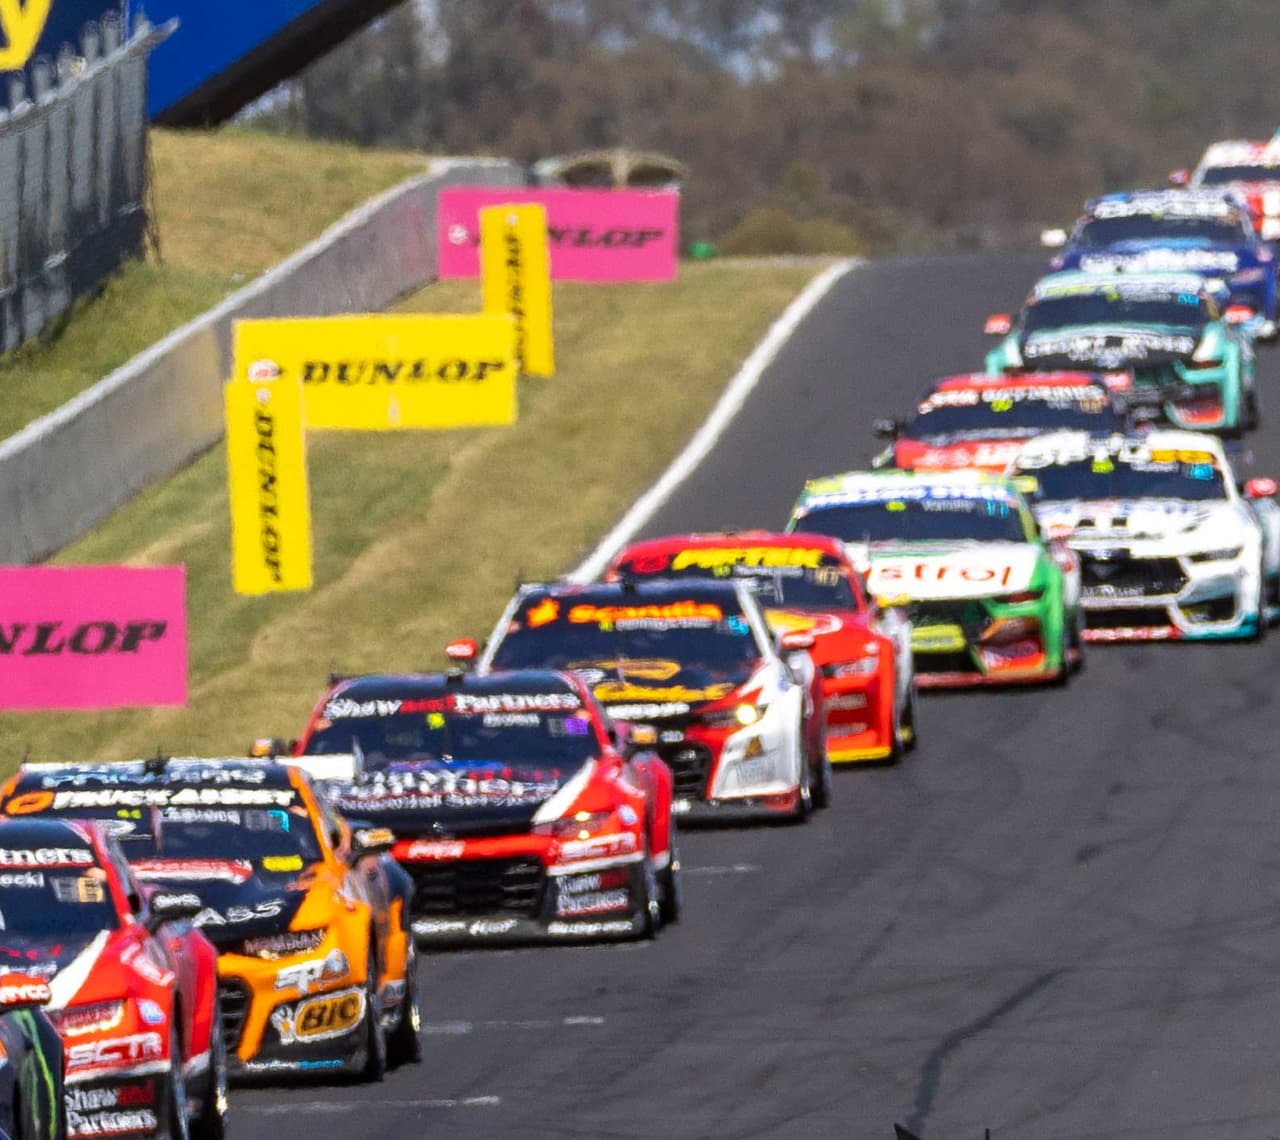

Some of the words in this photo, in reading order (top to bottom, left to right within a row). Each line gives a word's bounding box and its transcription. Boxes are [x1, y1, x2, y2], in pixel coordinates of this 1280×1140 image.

[549, 227, 665, 249] NLOP
[302, 358, 505, 384] DUNLOP
[253, 410, 284, 583] DUNLOP
[878, 564, 1013, 587] strol
[302, 998, 358, 1031] BIC
